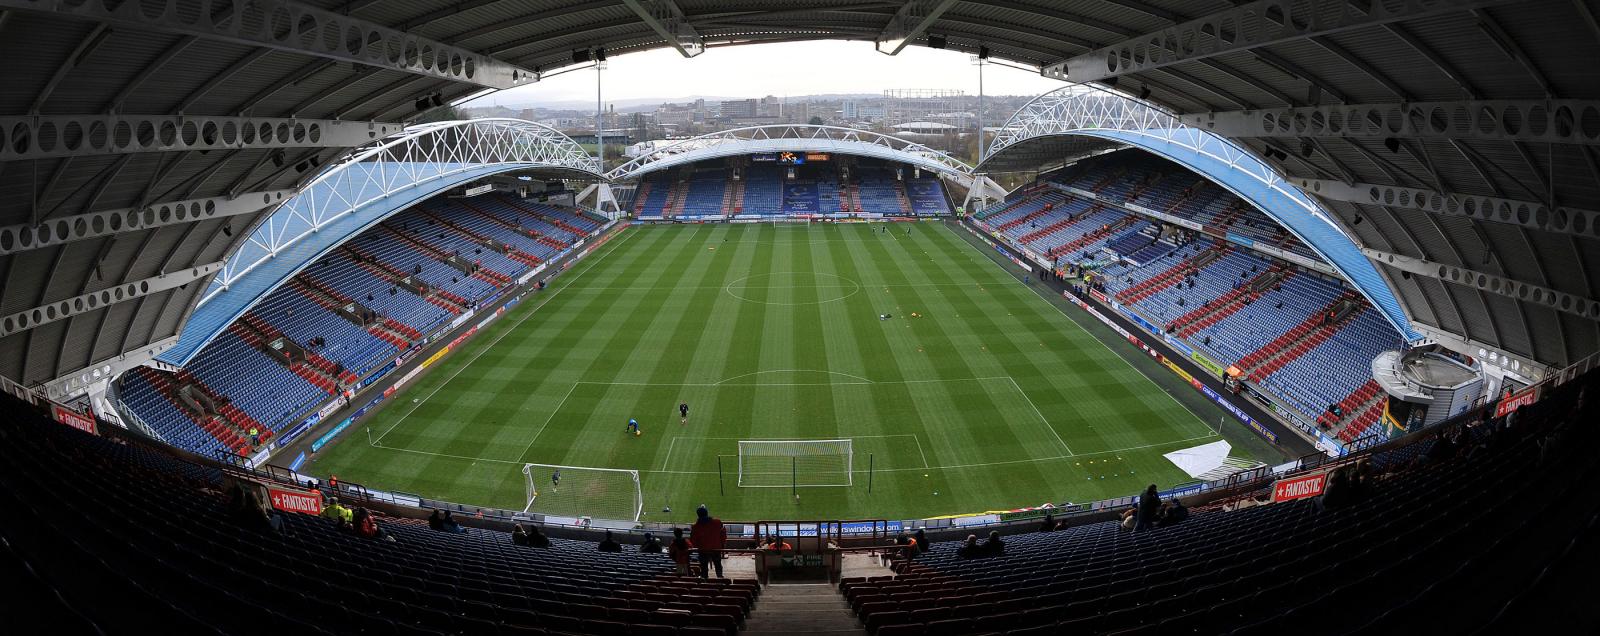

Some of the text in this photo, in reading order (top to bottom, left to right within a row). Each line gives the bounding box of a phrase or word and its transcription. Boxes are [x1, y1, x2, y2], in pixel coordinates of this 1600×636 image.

[1505, 393, 1533, 413] FANTASTIC
[65, 413, 93, 434] FANTASTIC
[1291, 415, 1310, 433] DISPLAY
[1285, 477, 1322, 497] FANTASTIC
[281, 493, 318, 512] FANTASTIC
